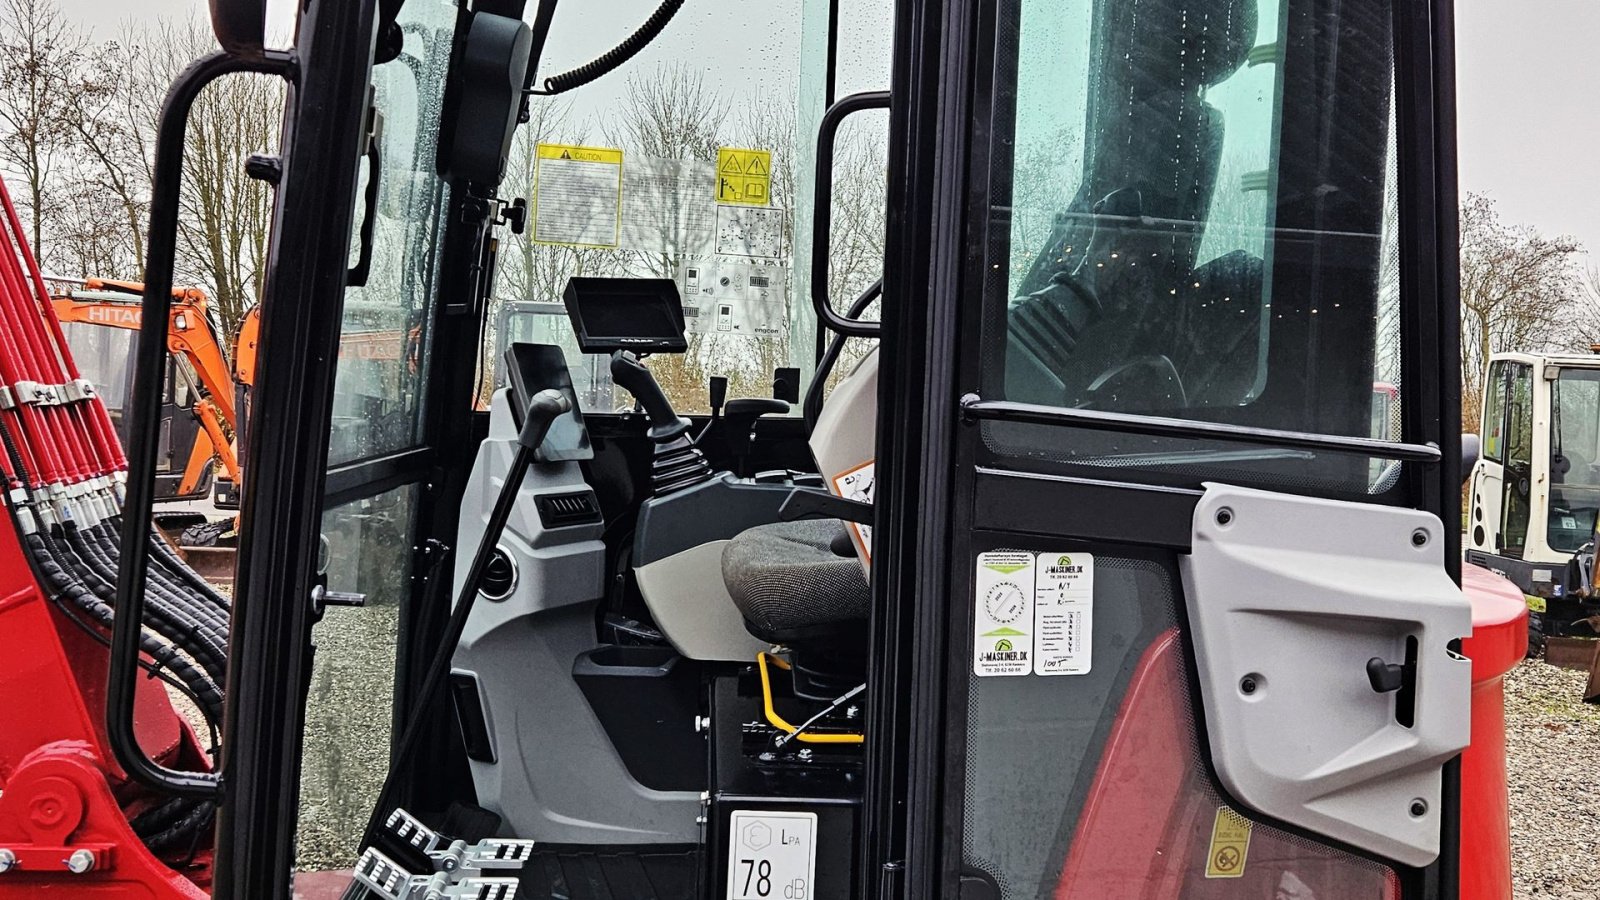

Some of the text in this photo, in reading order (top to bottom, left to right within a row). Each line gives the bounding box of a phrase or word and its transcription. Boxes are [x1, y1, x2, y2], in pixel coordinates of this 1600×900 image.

[575, 152, 602, 161] CAUTION
[754, 327, 779, 335] engcon
[1045, 565, 1083, 574] J-MASKINER.DK
[979, 651, 1028, 662] J-MASKINER.DK
[741, 859, 806, 900] 78 dB
